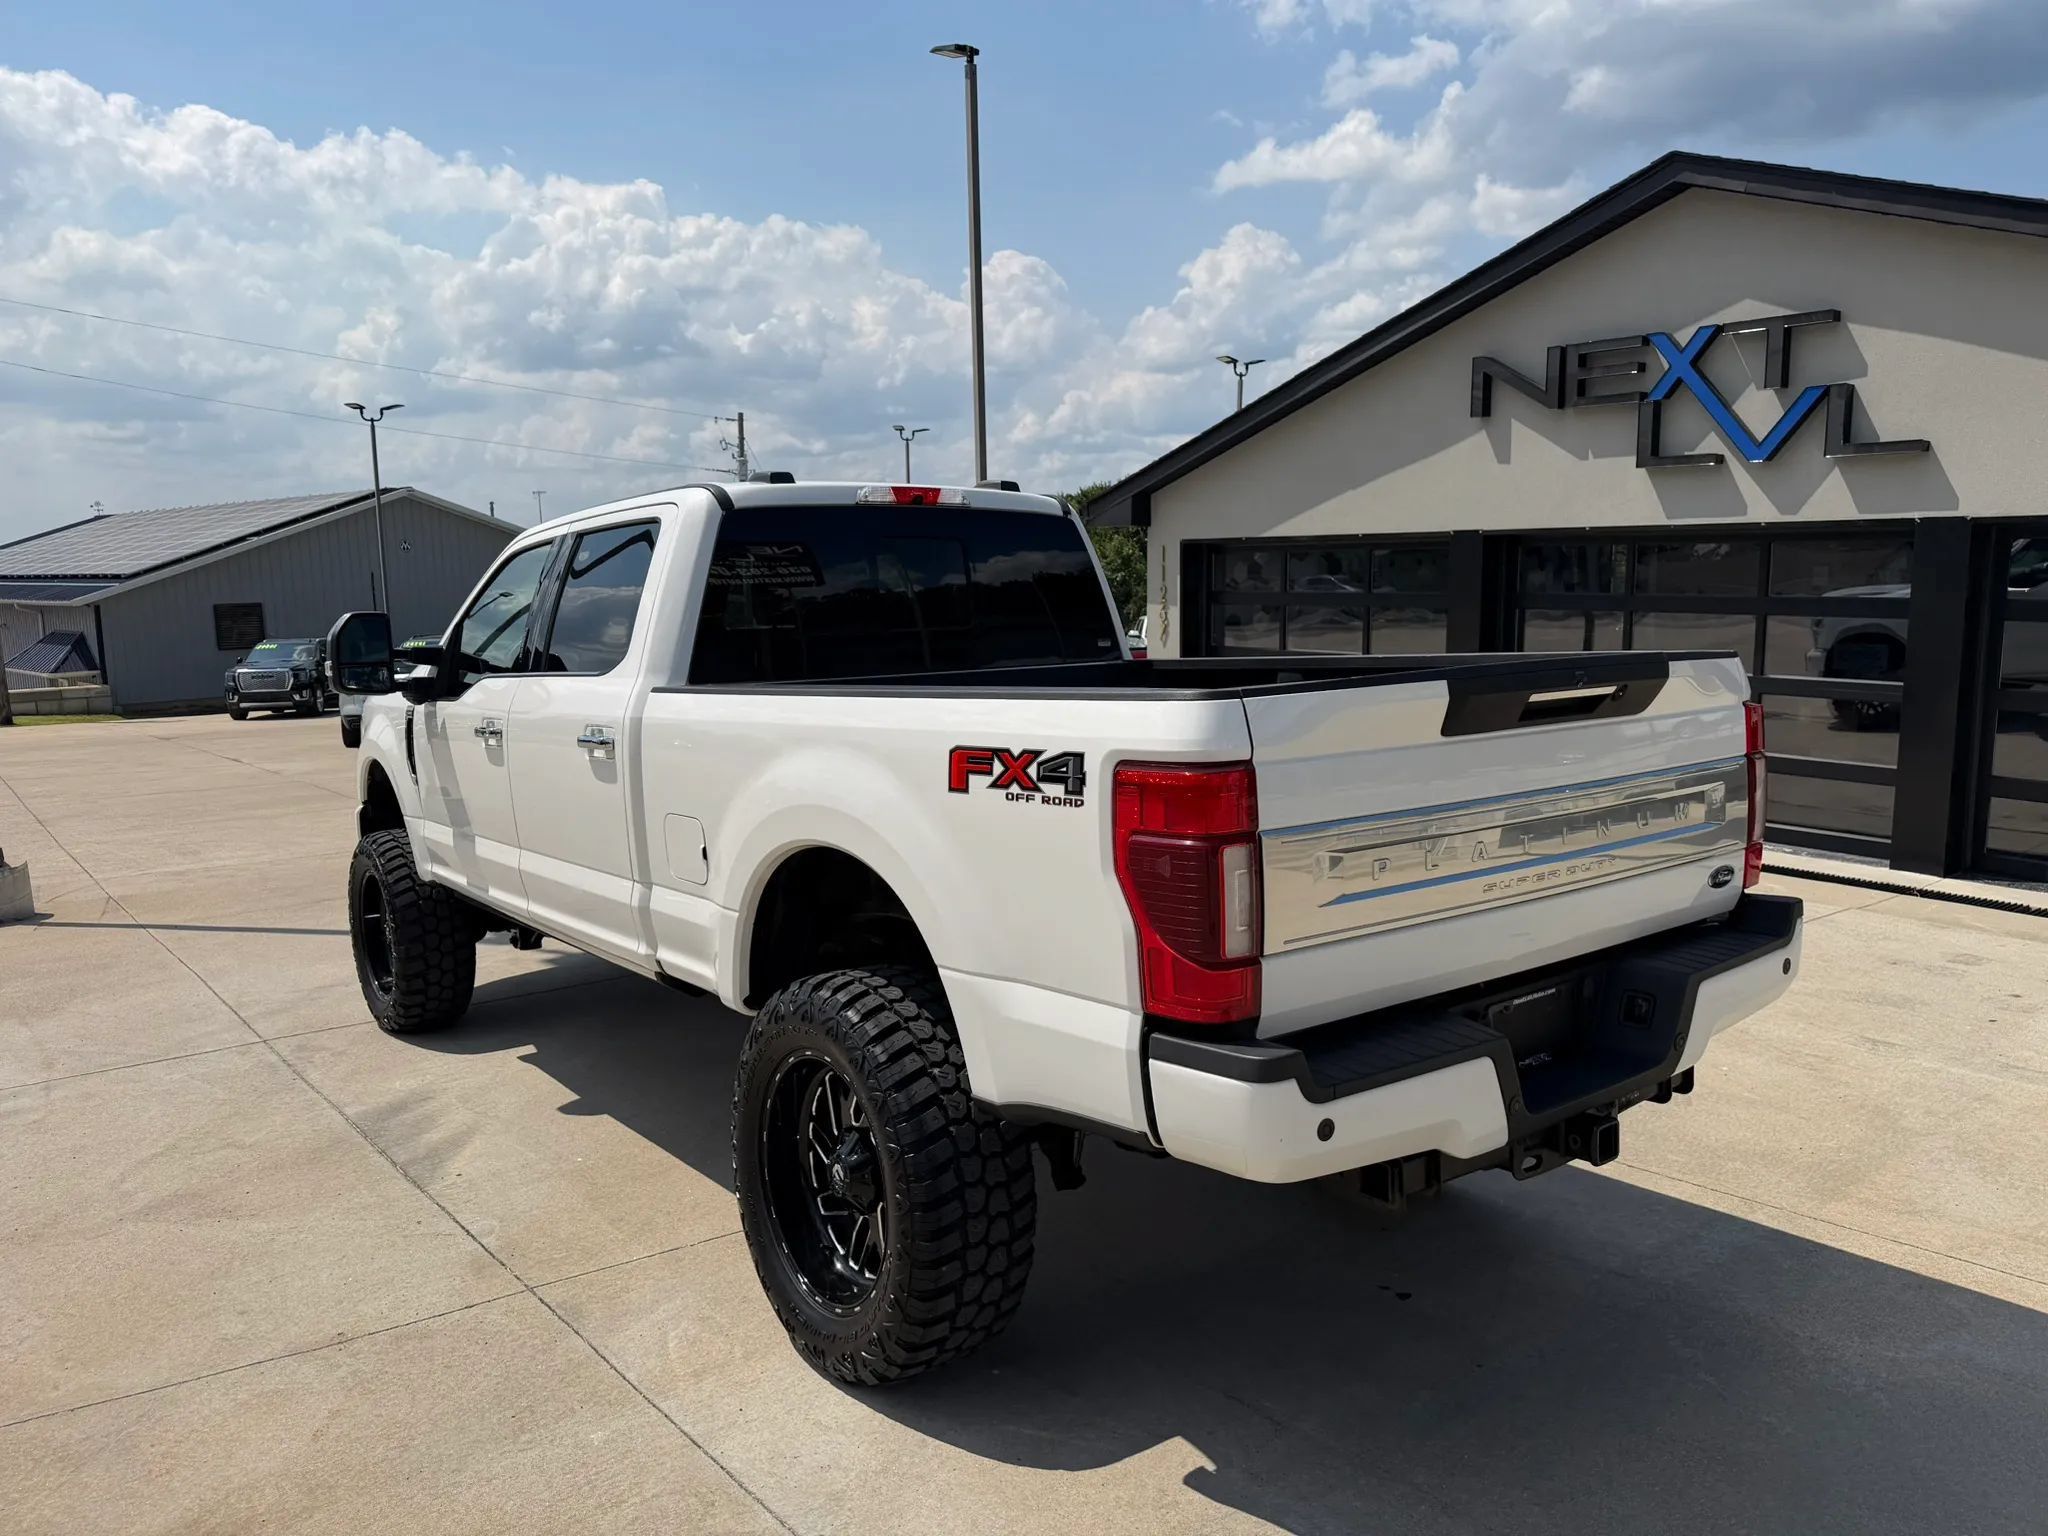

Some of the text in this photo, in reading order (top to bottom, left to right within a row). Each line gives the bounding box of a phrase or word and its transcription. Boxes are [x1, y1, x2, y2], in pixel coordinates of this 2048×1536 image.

[1470, 308, 1841, 418] NEXT
[1636, 383, 1930, 468] LVL
[948, 745, 1087, 798] FX4
[1005, 792, 1085, 808] OFF ROAD
[1372, 803, 1690, 881] PLATINUM
[1482, 857, 1619, 894] SUPER DUTY
